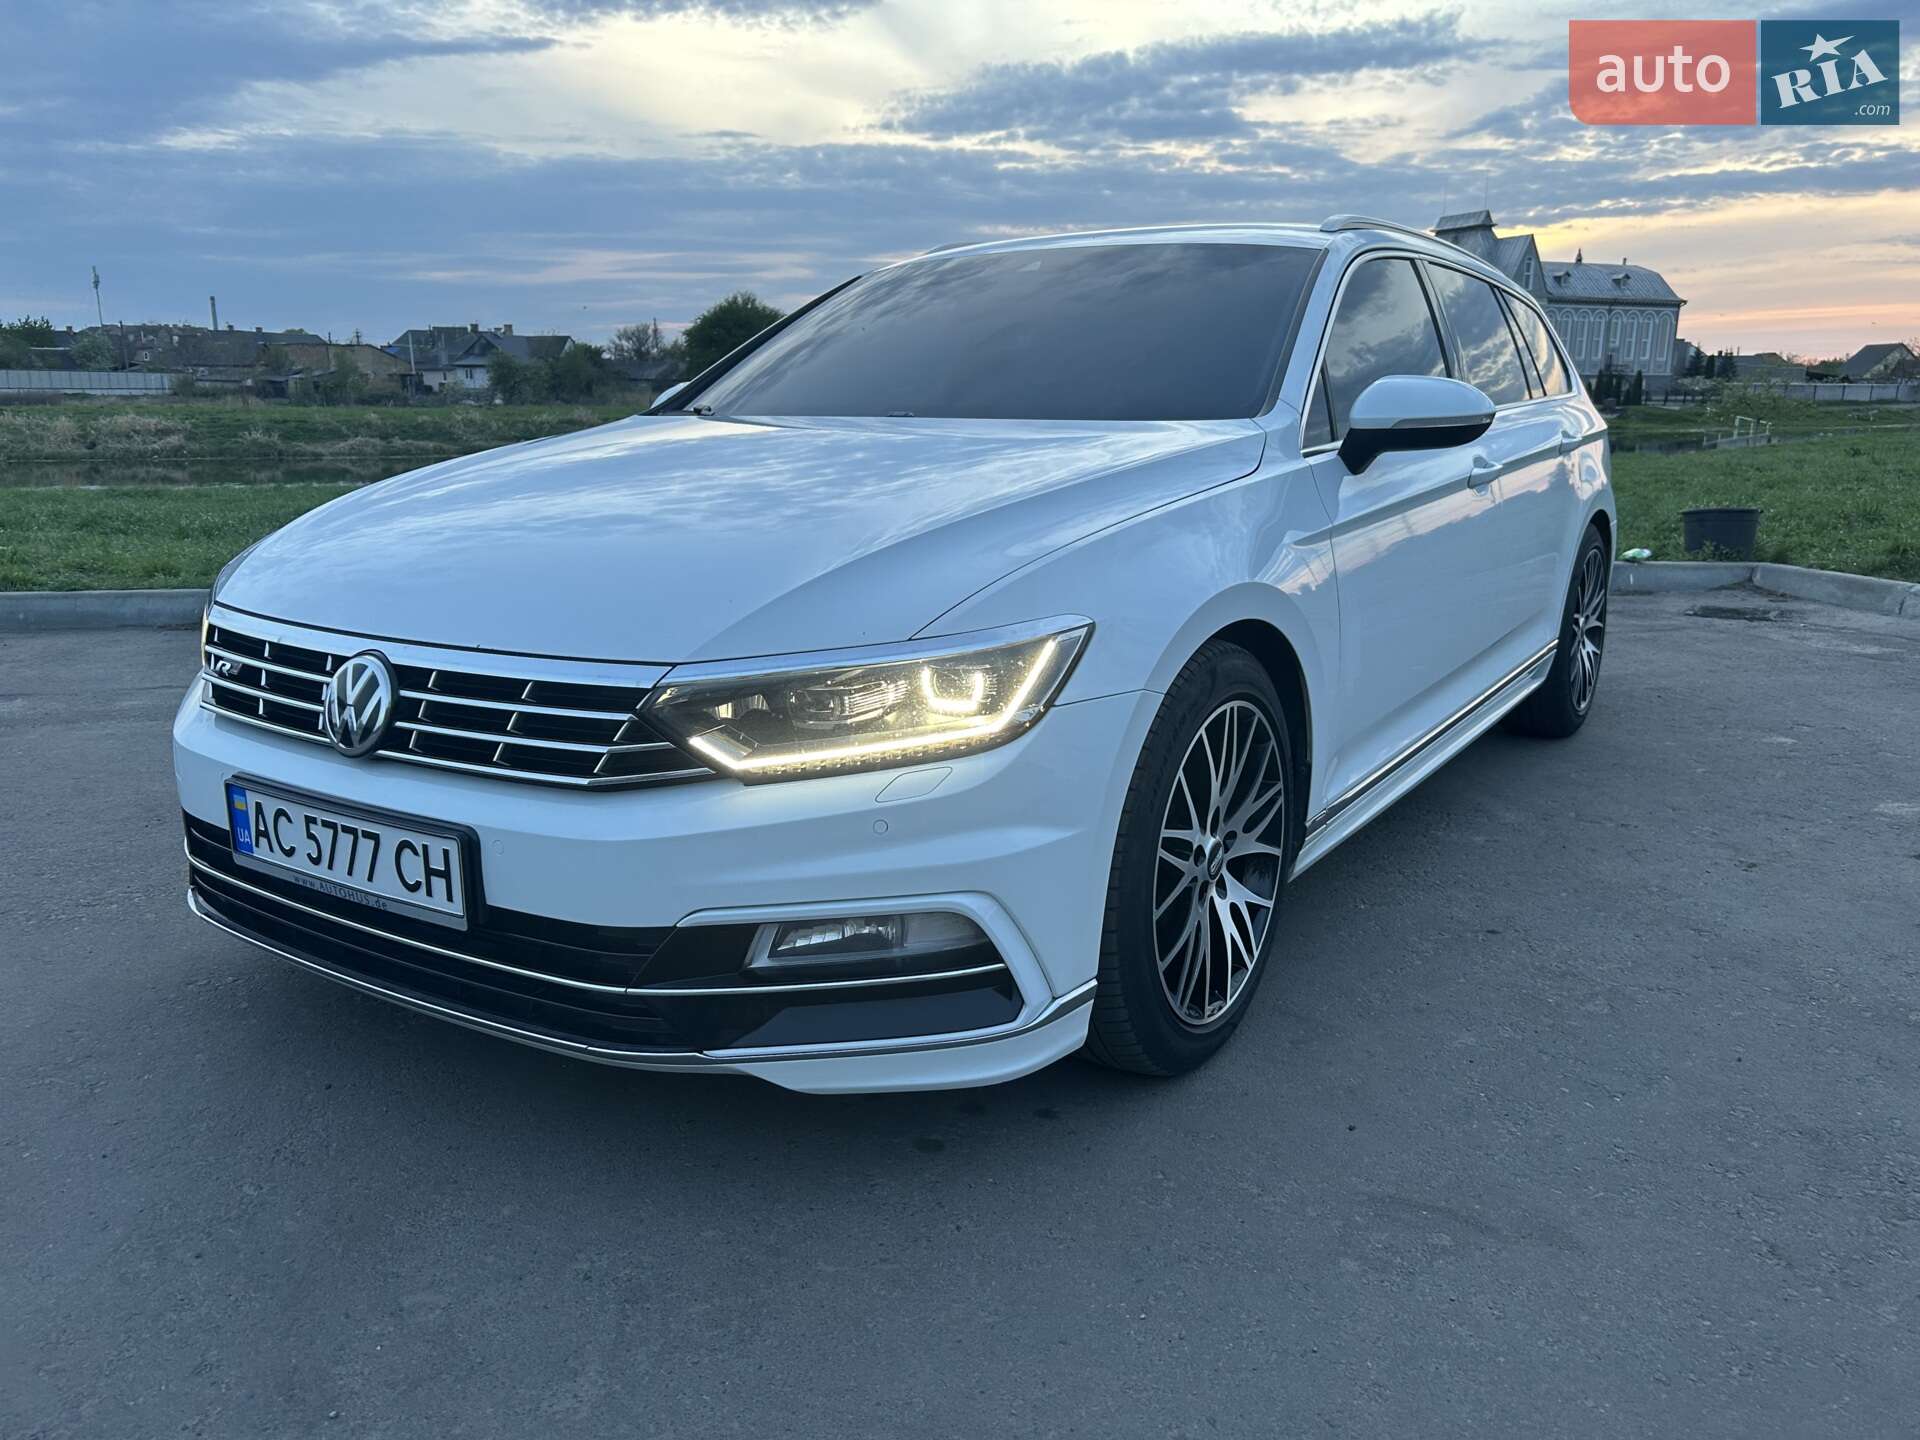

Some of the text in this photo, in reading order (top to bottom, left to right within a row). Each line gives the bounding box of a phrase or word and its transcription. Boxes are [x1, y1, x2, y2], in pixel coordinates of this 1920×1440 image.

[237, 827, 251, 844] UA
[254, 800, 454, 903] AC 5777 CH
